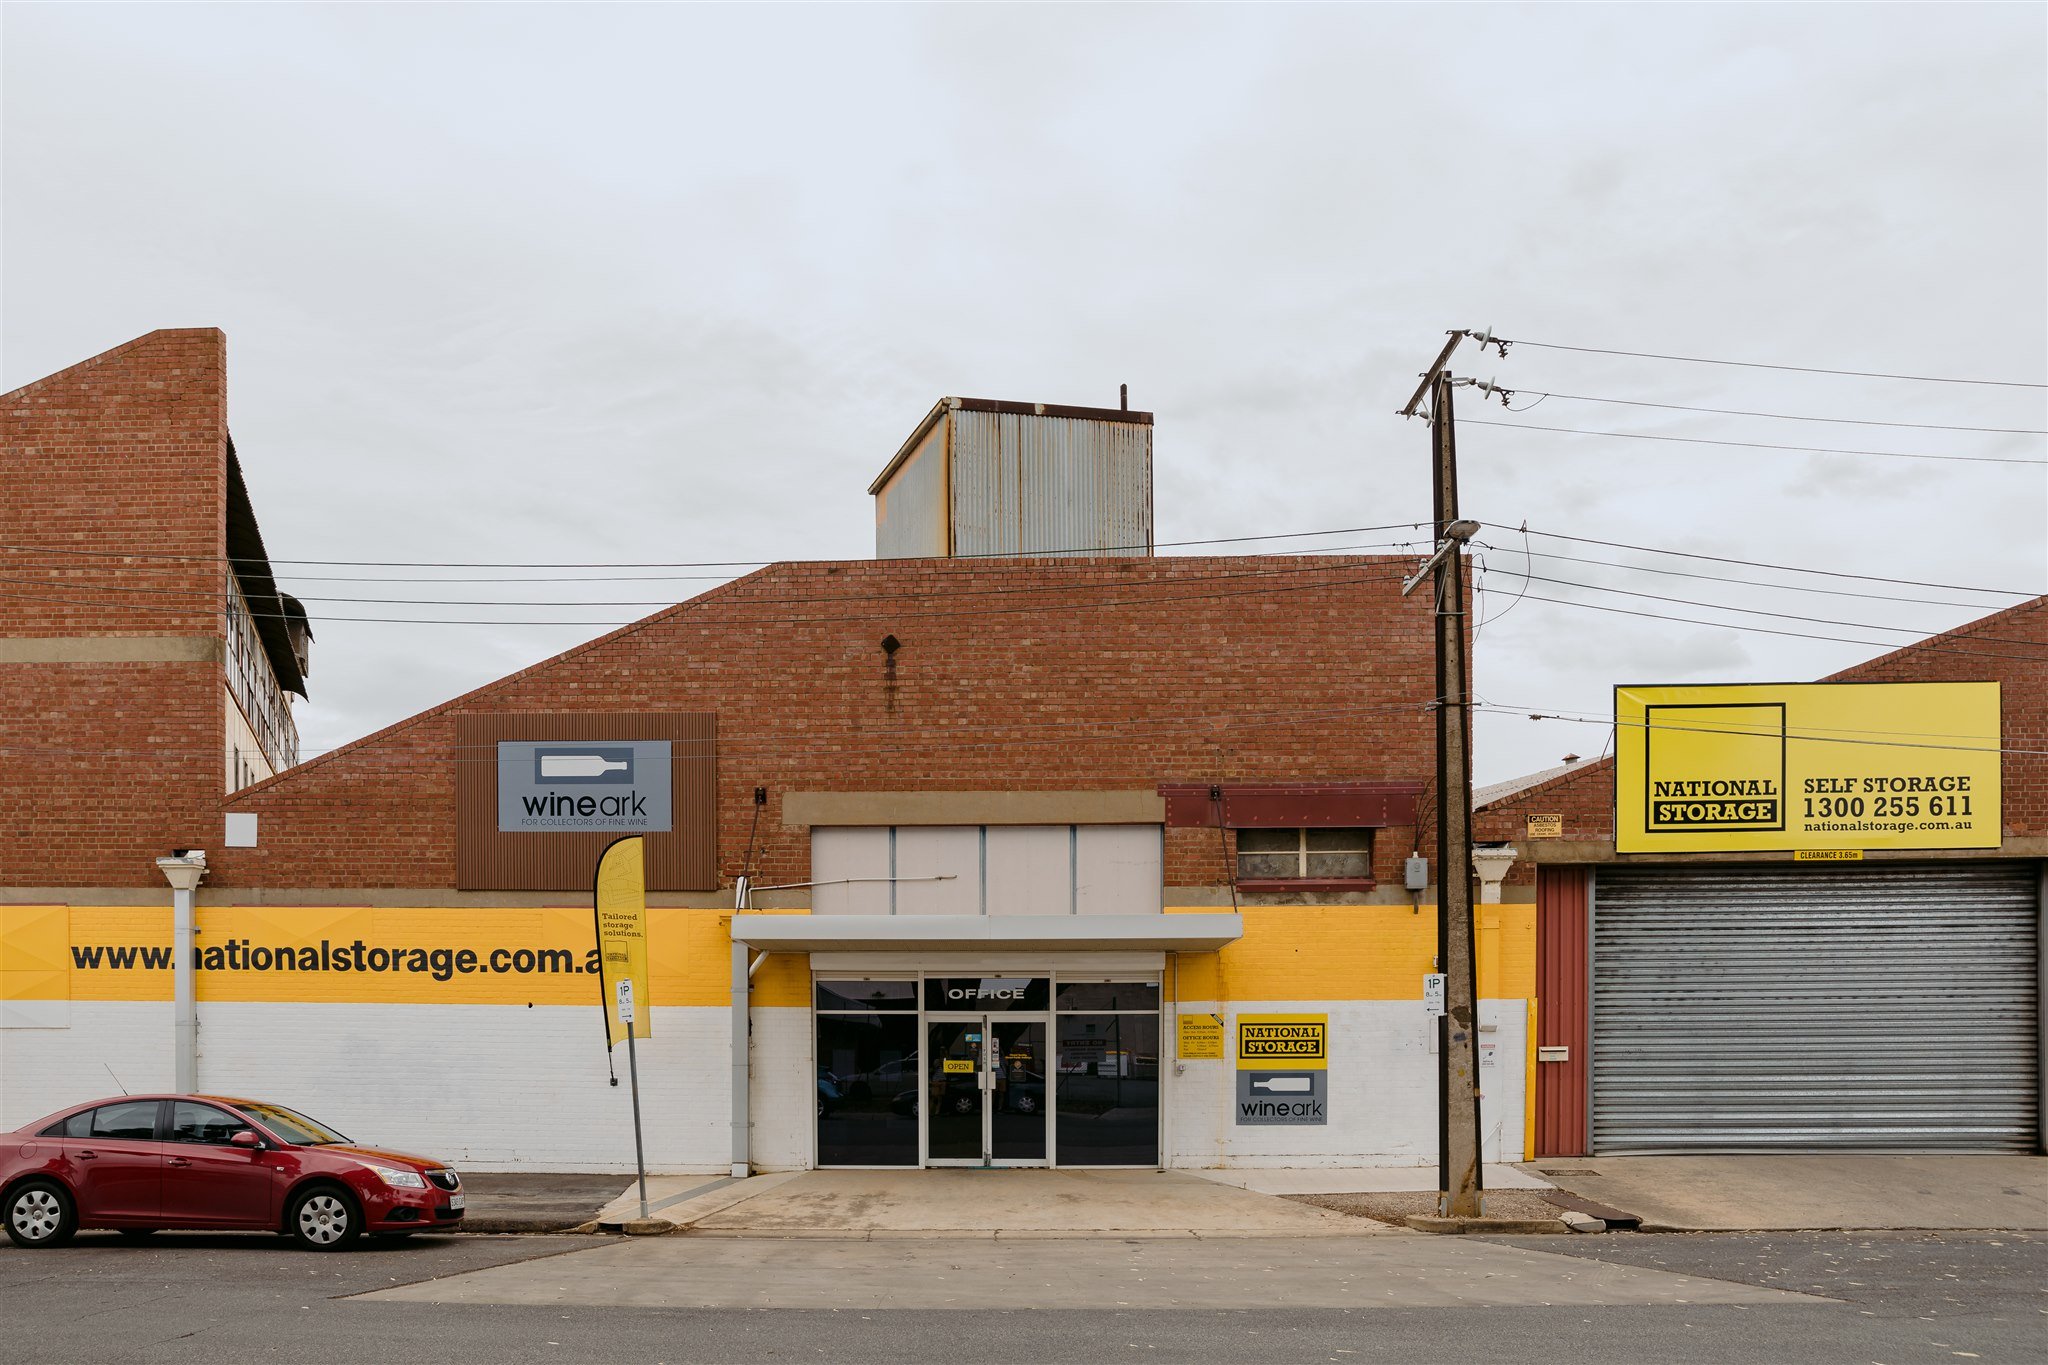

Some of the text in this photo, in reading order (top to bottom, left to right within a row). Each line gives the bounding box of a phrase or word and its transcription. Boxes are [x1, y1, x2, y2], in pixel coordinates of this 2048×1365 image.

[1654, 780, 1777, 797] NATIONAL
[1804, 776, 1971, 794] SELF STORAGE
[1659, 802, 1772, 821] STORAGE
[1804, 795, 1972, 818] 1300 255 611
[521, 818, 648, 826] FOR COLLECTORS OF FINE WINE
[1531, 815, 1559, 823] CAUTION
[1804, 820, 1972, 833] nationalstorage.com.au
[1800, 851, 1858, 859] CLEARANCE 3.65m
[602, 912, 638, 921] Tailored
[603, 921, 634, 930] storage
[604, 929, 644, 938] solutions.
[1428, 978, 1441, 989] 1P
[620, 985, 630, 996] 1P
[948, 988, 1025, 999] OFFICE
[1245, 1027, 1320, 1038] NATIONAL
[1248, 1041, 1316, 1053] STORAGE
